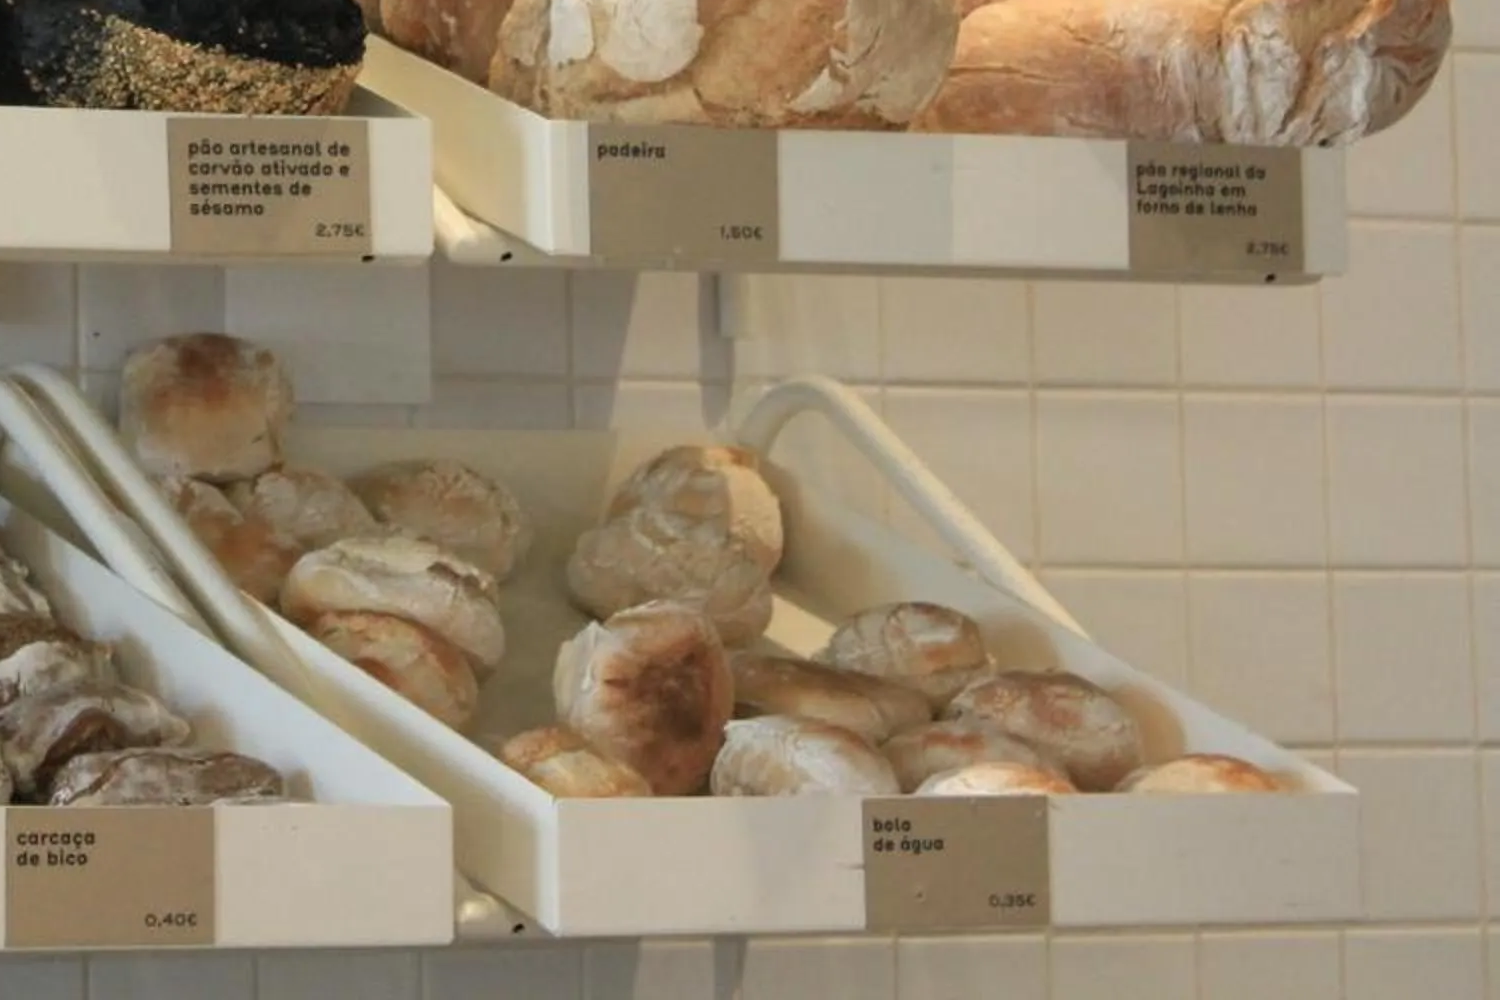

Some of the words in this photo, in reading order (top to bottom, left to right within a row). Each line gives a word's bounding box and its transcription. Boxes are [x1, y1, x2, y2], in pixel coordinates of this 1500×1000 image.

[187, 138, 224, 160] pão
[229, 141, 322, 157] artesanal
[327, 141, 351, 158] de
[596, 141, 666, 161] padeira
[187, 157, 255, 176] carvão
[261, 159, 334, 177] ativado
[338, 164, 350, 177] e
[188, 181, 284, 197] sementes
[288, 181, 312, 197] de
[189, 198, 265, 216] sésamo
[16, 831, 96, 851] carcaça
[872, 837, 895, 853] de
[16, 850, 40, 867] de
[46, 847, 89, 867] bico
[144, 912, 198, 928] 0,40€
